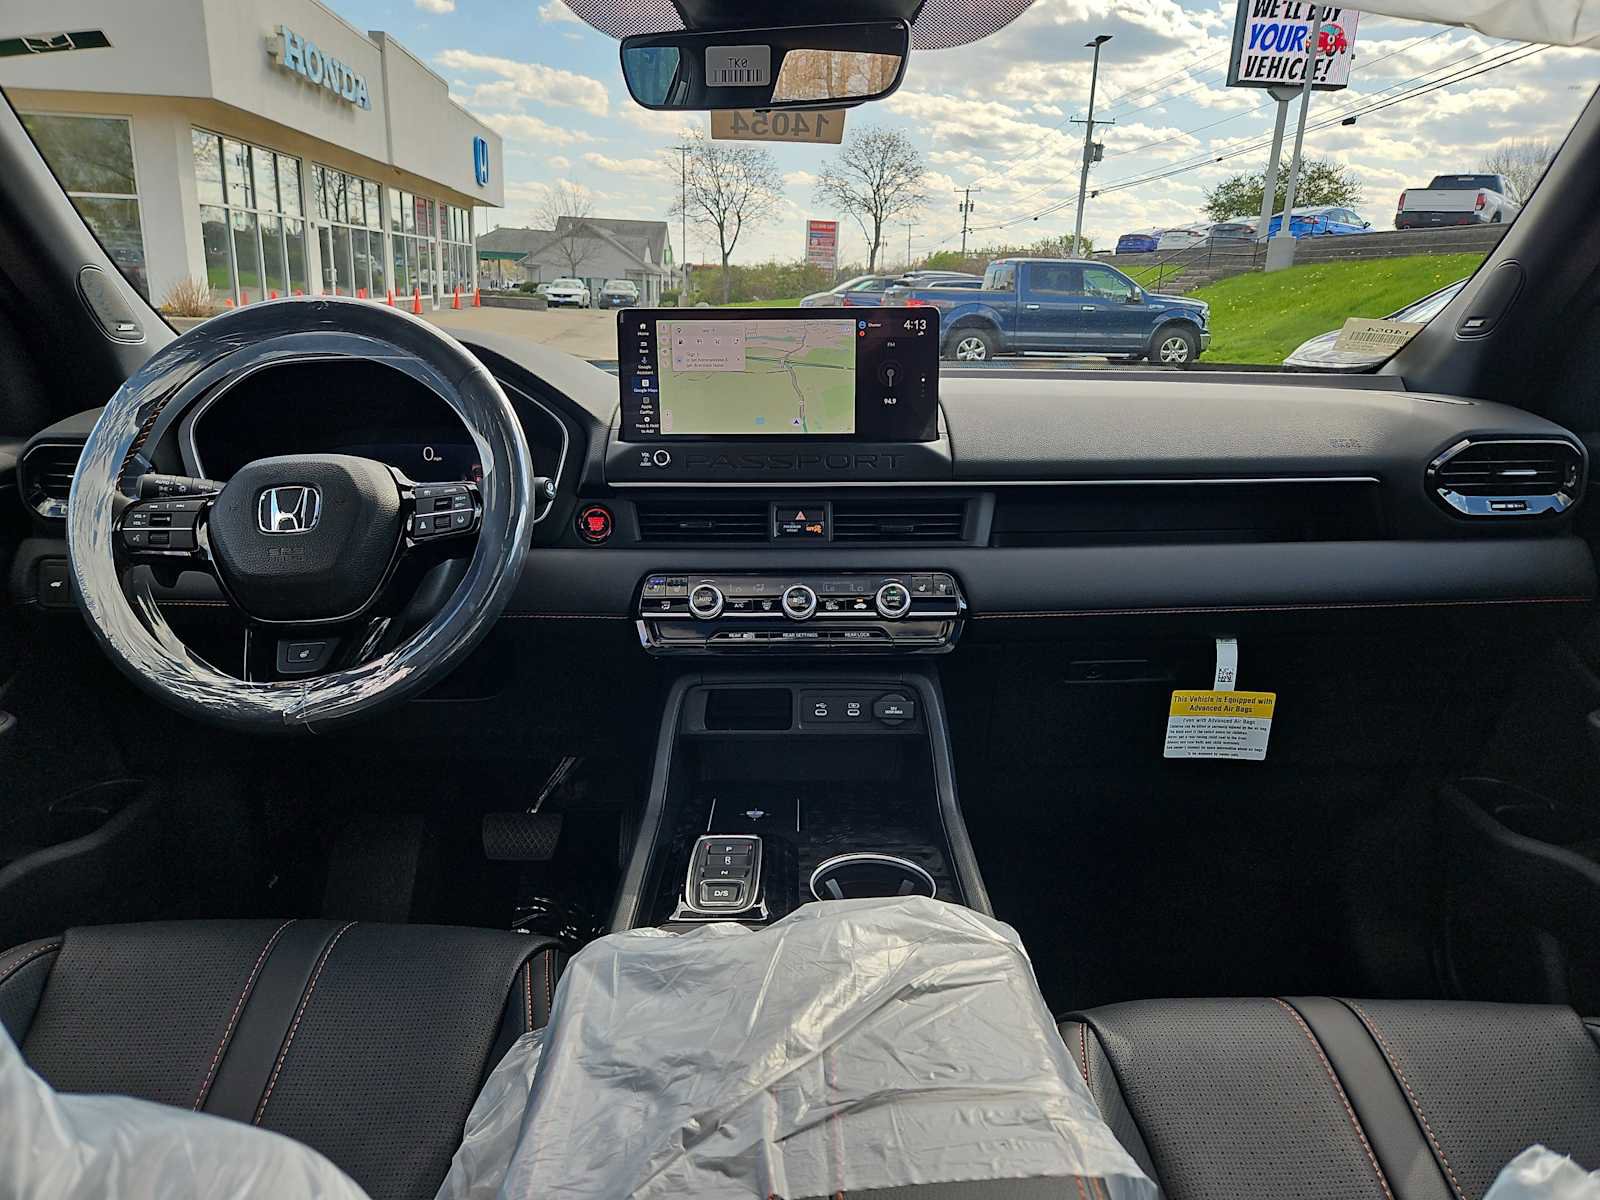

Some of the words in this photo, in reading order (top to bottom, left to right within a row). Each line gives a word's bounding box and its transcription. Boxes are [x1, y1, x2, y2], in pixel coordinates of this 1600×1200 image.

[1248, 23, 1308, 53] YOUR
[280, 24, 371, 112] HONDA
[1244, 55, 1334, 82] VEHICLE!
[903, 319, 927, 331] 4:13
[423, 446, 434, 461] 0
[683, 453, 905, 471] PASSPORT
[1174, 695, 1188, 703] This
[1189, 695, 1215, 703] Vehicle
[1224, 696, 1256, 705] Equipped
[1189, 704, 1222, 712] Advanced
[1235, 705, 1252, 713] Bags
